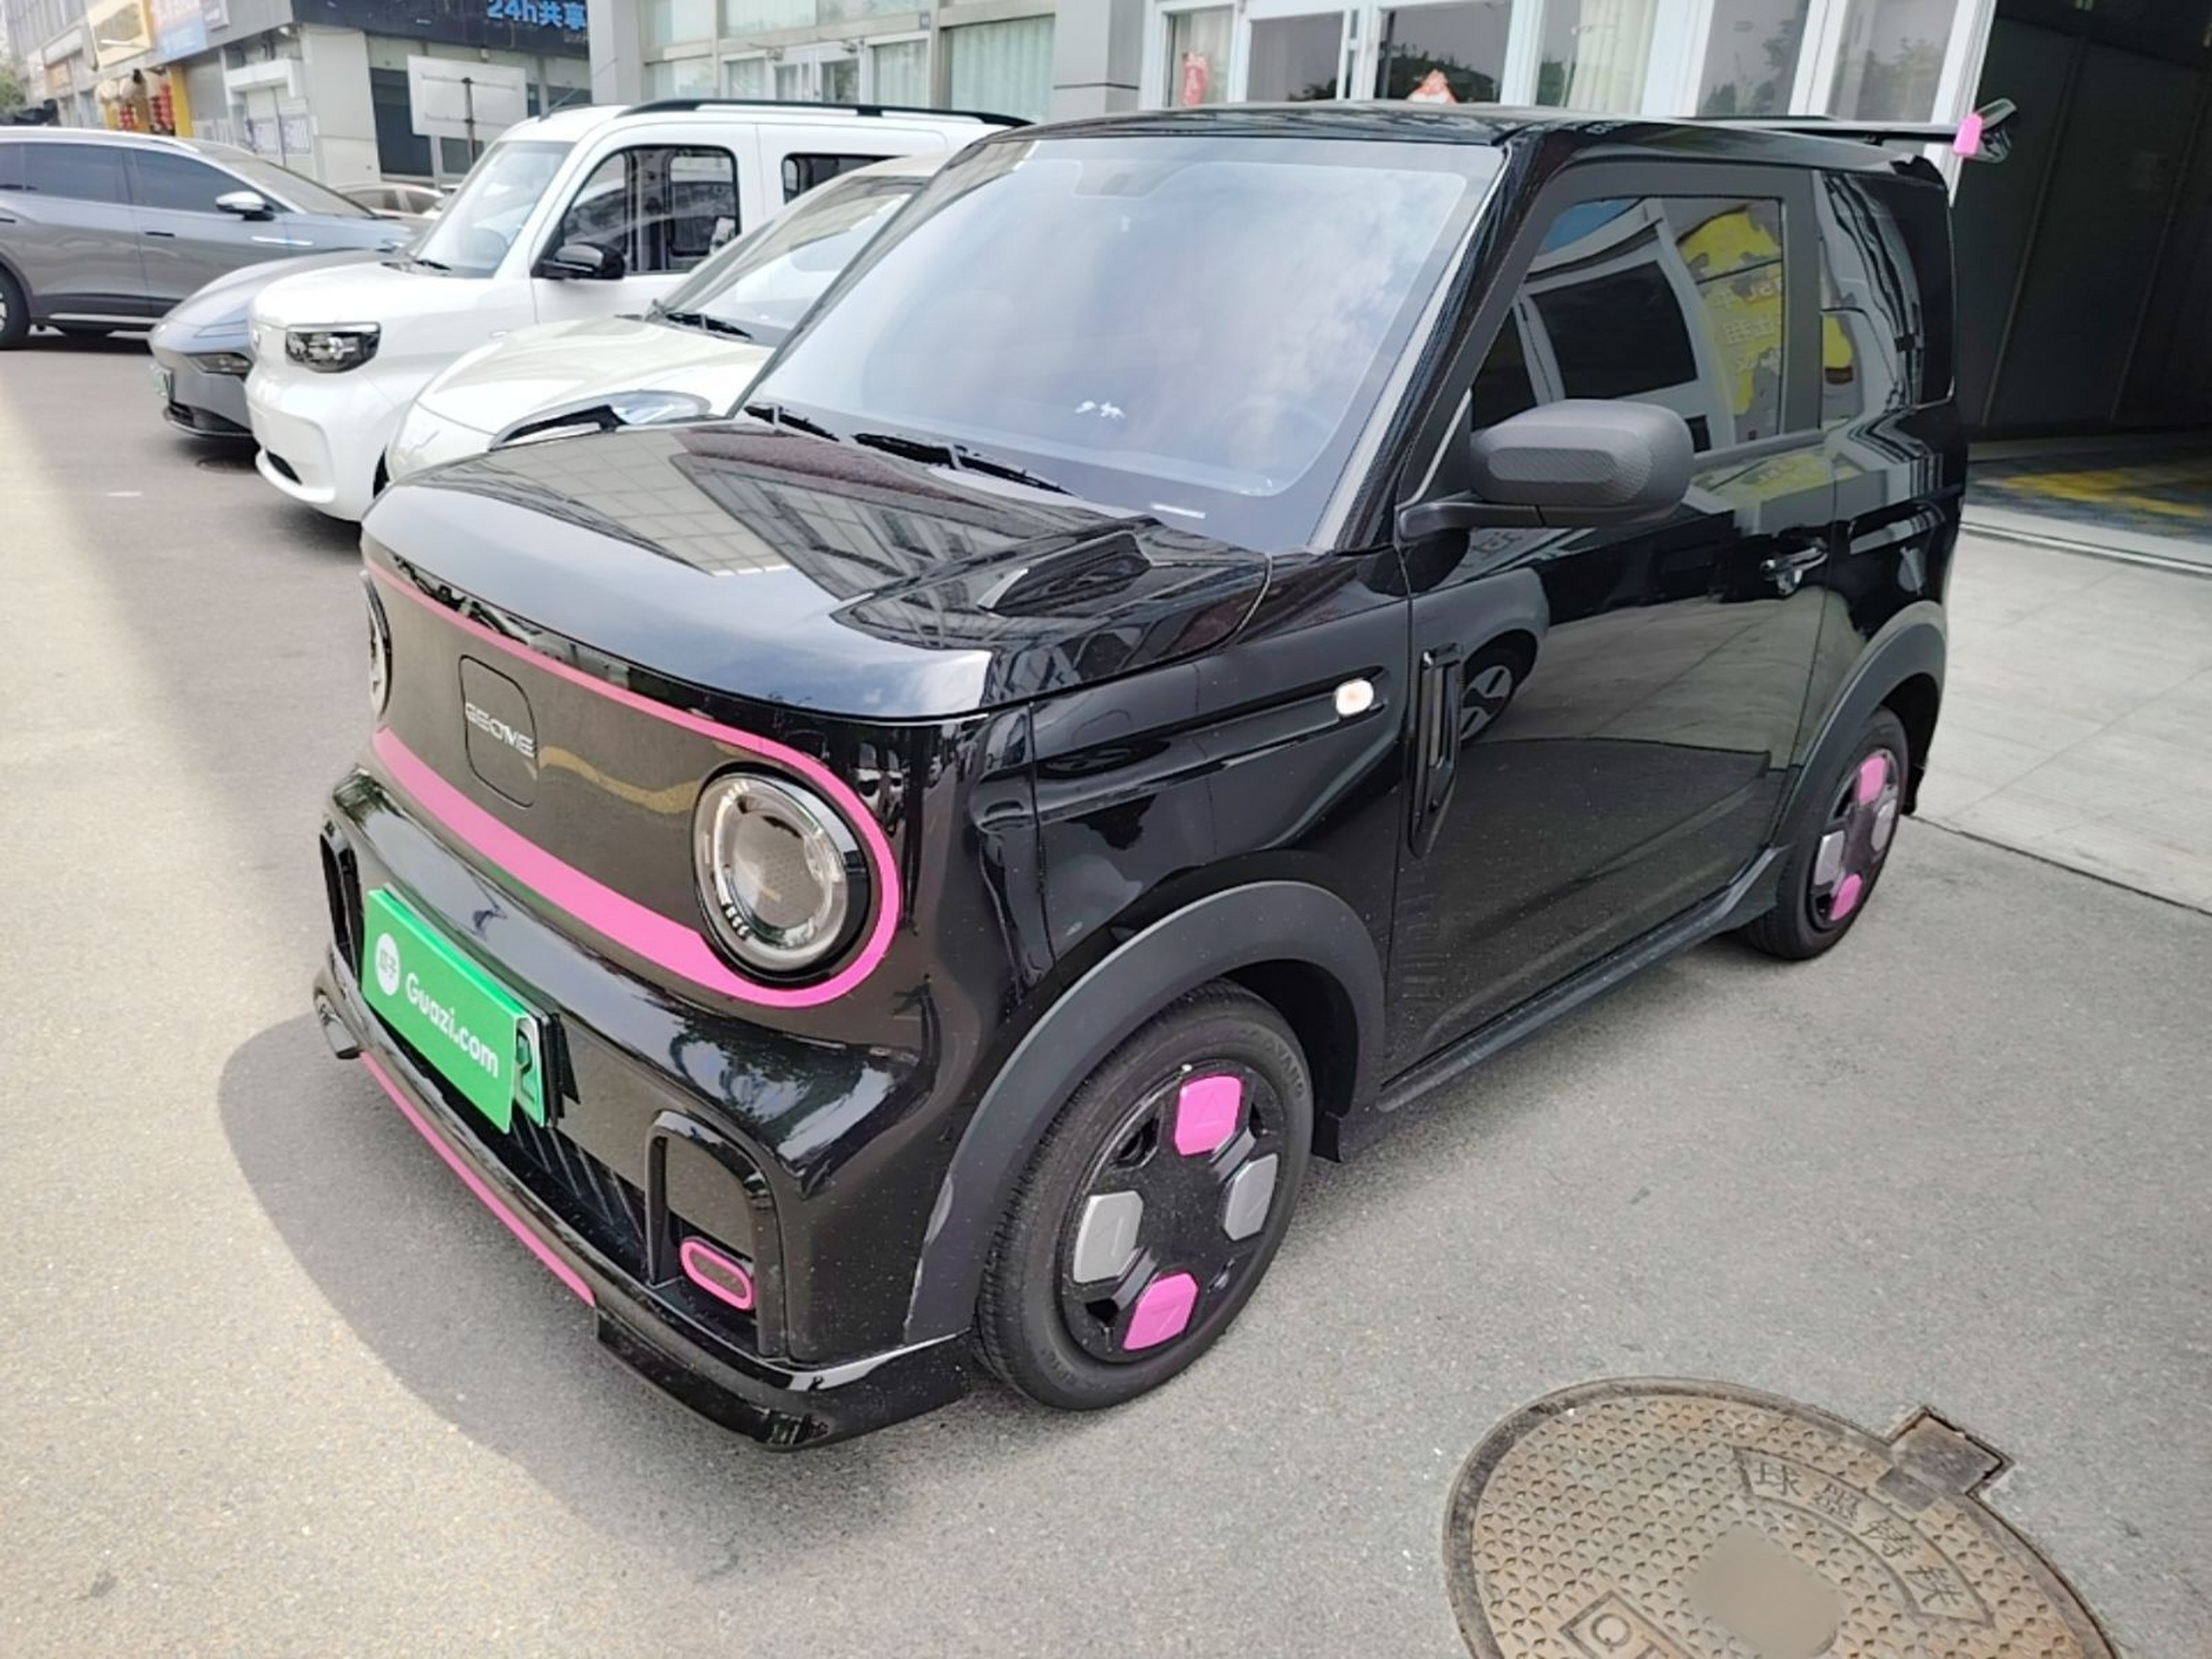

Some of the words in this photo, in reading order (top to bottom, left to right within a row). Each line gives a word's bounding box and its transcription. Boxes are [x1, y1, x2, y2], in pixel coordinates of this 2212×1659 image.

[406, 972, 499, 1078] Guazi.com
[1754, 1461, 1965, 1609] 球墨铸铁
